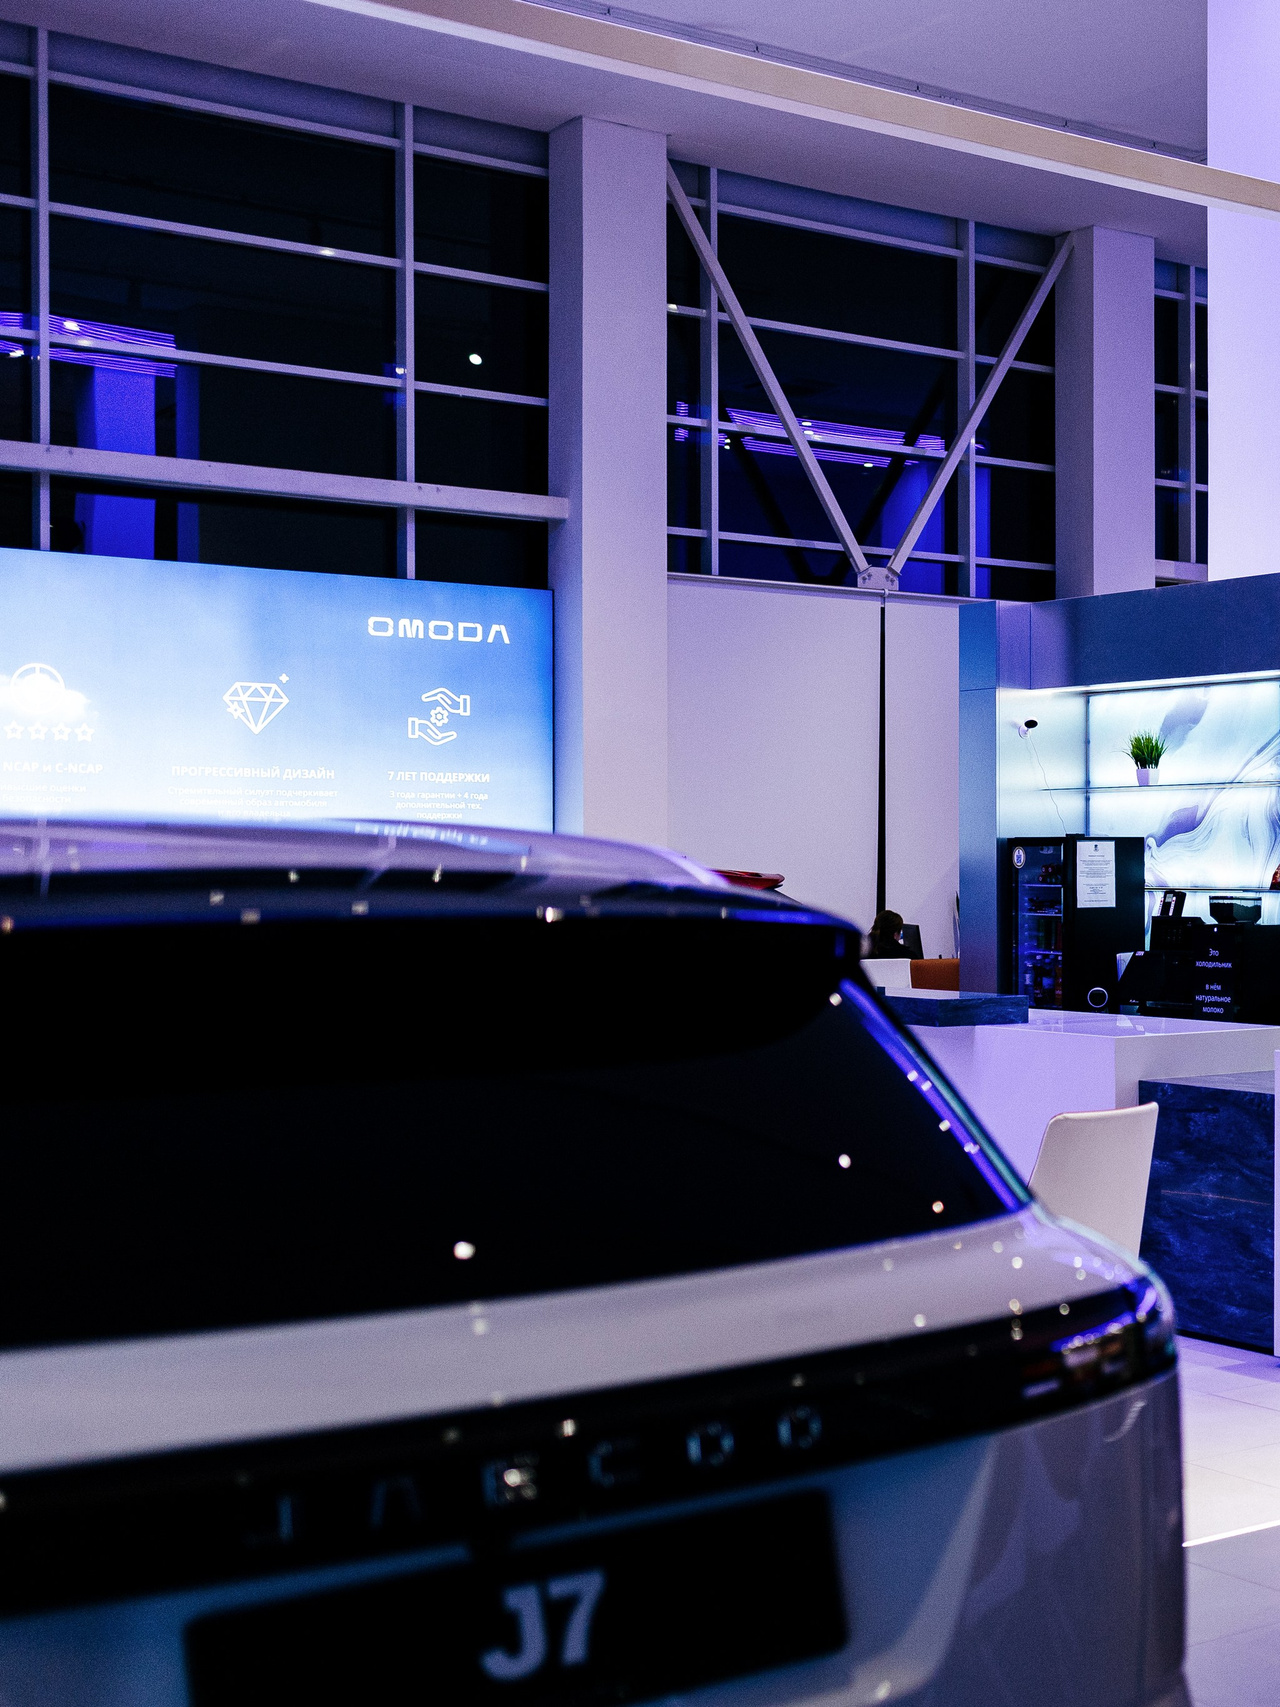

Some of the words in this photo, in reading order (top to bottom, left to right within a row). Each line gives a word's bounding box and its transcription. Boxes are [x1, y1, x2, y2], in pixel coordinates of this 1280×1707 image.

[368, 616, 510, 644] OMODA
[3, 761, 39, 772] NCAP
[55, 762, 103, 774] C-NCAP
[171, 765, 280, 778] ПРОГРЕССИВНЫЙ
[282, 766, 335, 781] ДИЗАЙН
[387, 771, 395, 781] 7
[396, 772, 417, 781] ЛЕТ
[420, 772, 490, 784] ПОДДЕРЖКИ
[168, 786, 243, 797] Стремительный
[244, 788, 273, 797] силуэт
[276, 789, 338, 798] подчеркивает
[389, 790, 395, 798] 3
[397, 792, 416, 800] года
[417, 792, 456, 801] гарантии
[470, 793, 489, 801] года
[396, 801, 466, 810] дополнительной
[417, 812, 463, 820] поддержки
[1209, 948, 1219, 957] Это
[1195, 995, 1231, 1003] натуральное
[480, 1571, 606, 1684] J7
